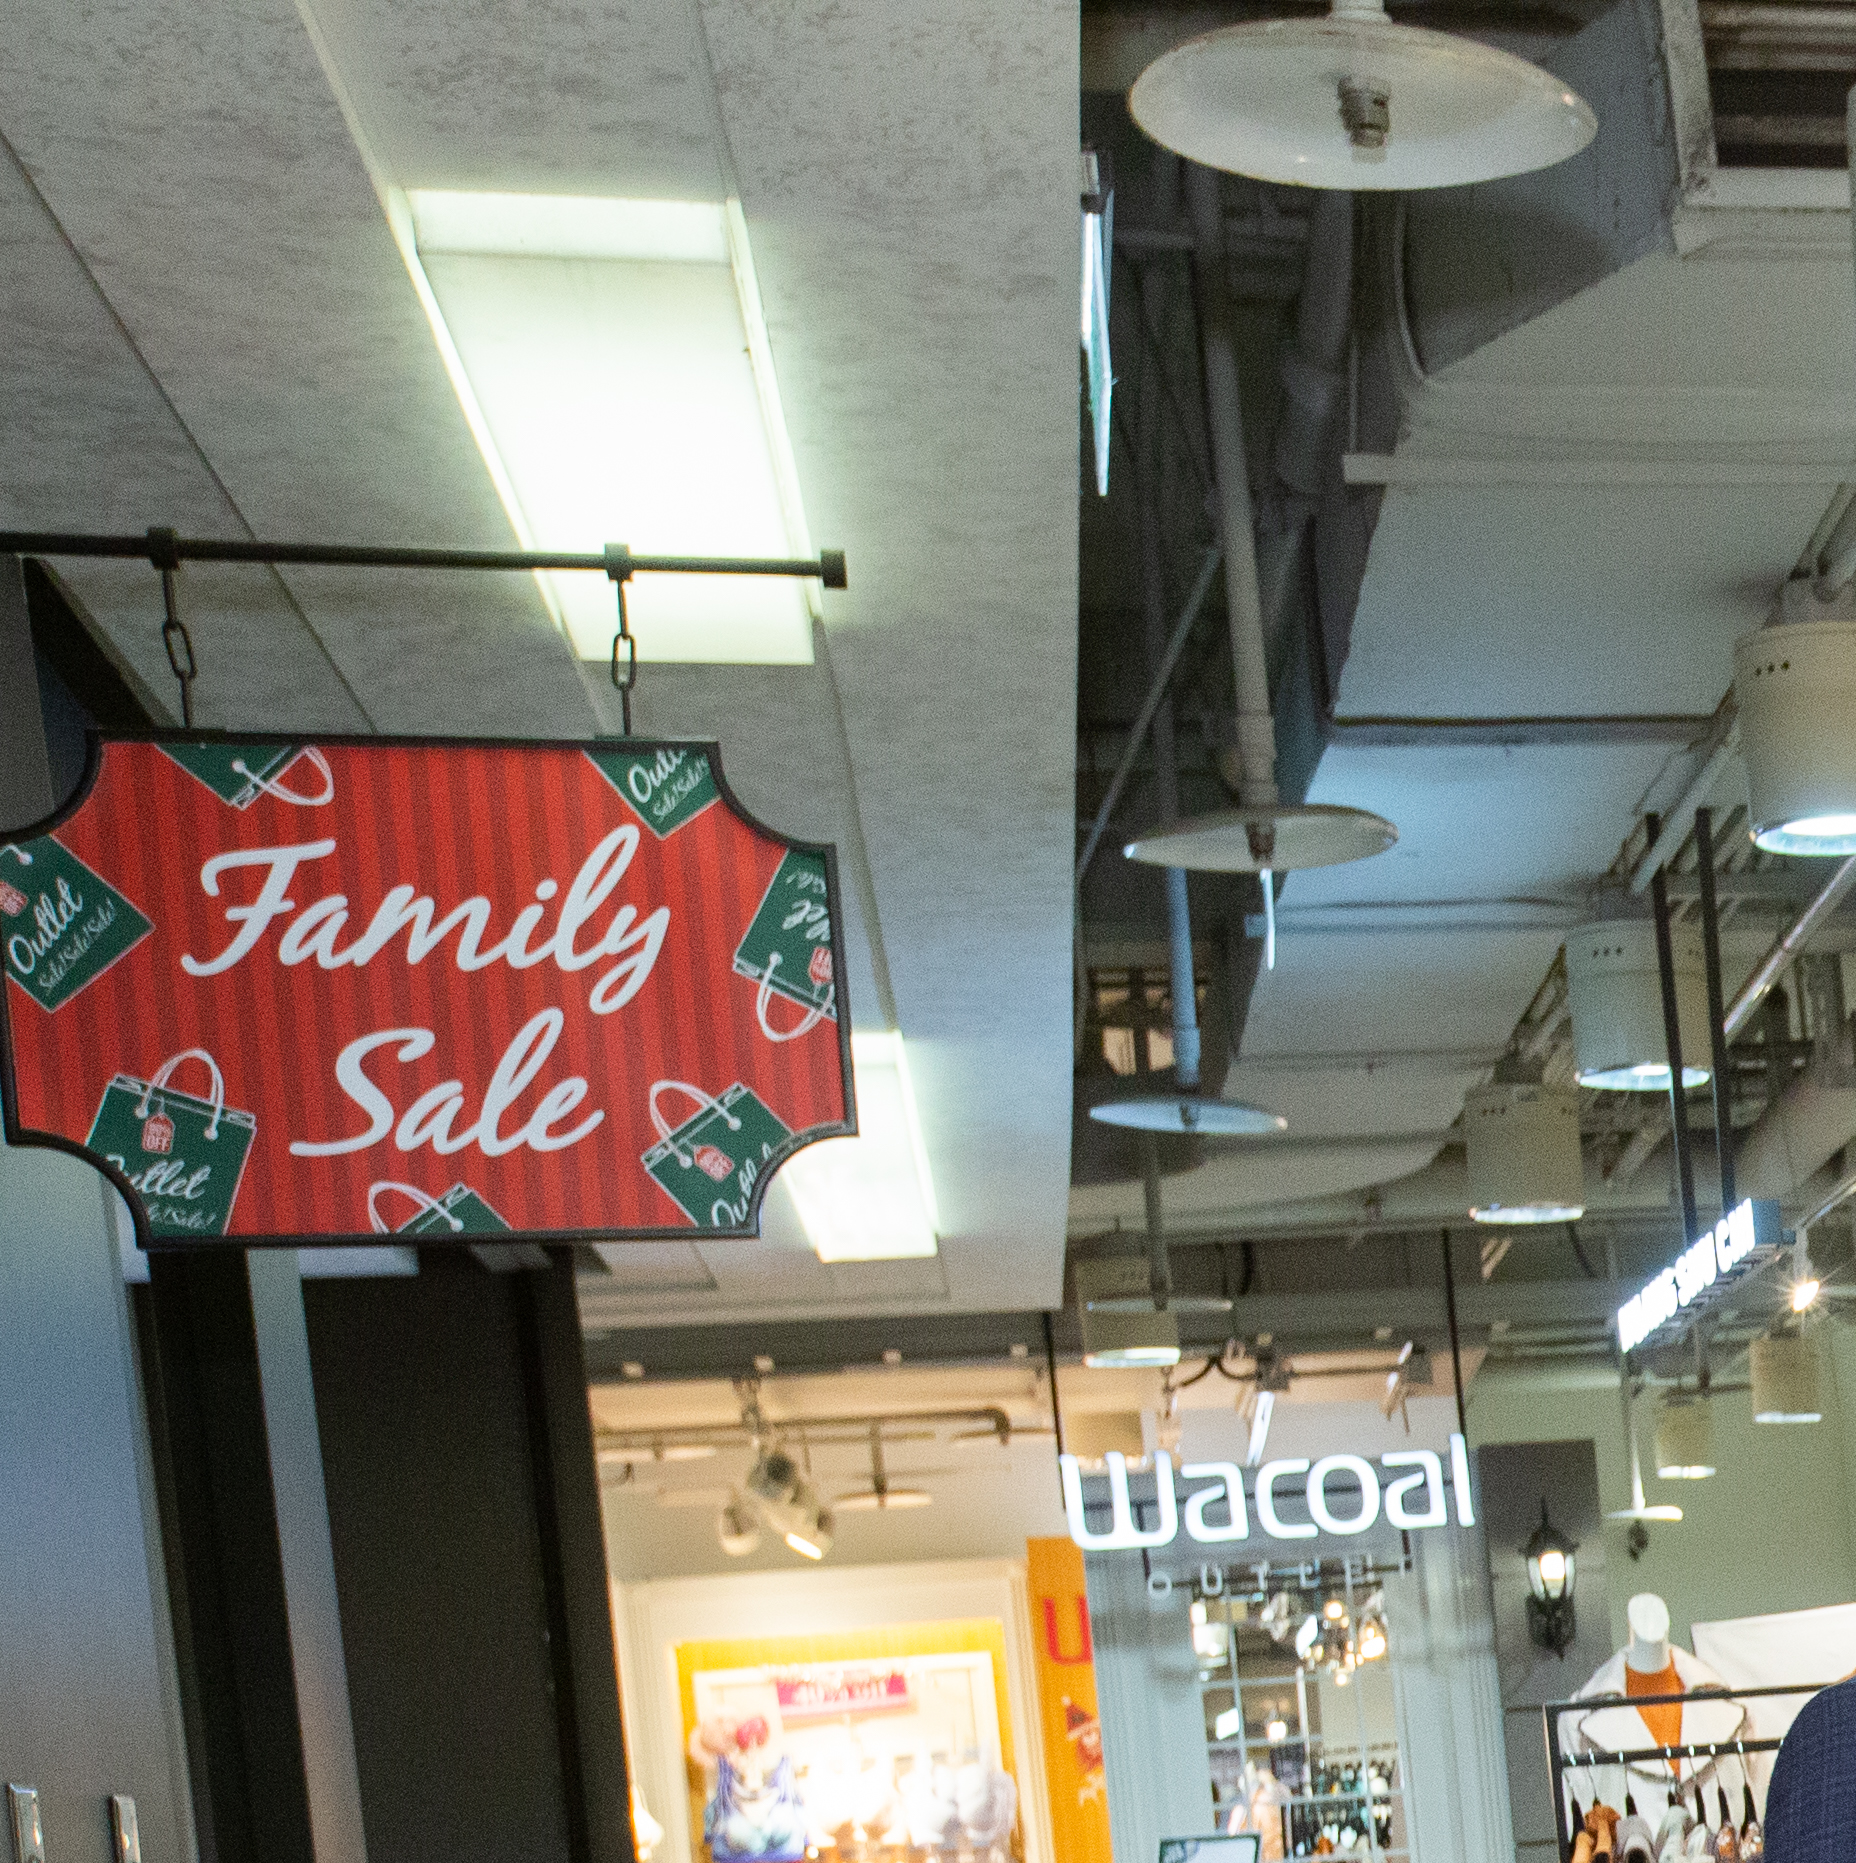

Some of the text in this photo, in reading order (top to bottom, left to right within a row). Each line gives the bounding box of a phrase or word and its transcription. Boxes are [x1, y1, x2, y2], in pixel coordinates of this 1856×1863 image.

[9, 876, 83, 975] Outlet
[181, 823, 670, 1016] Family
[290, 1008, 604, 1158] Sale
